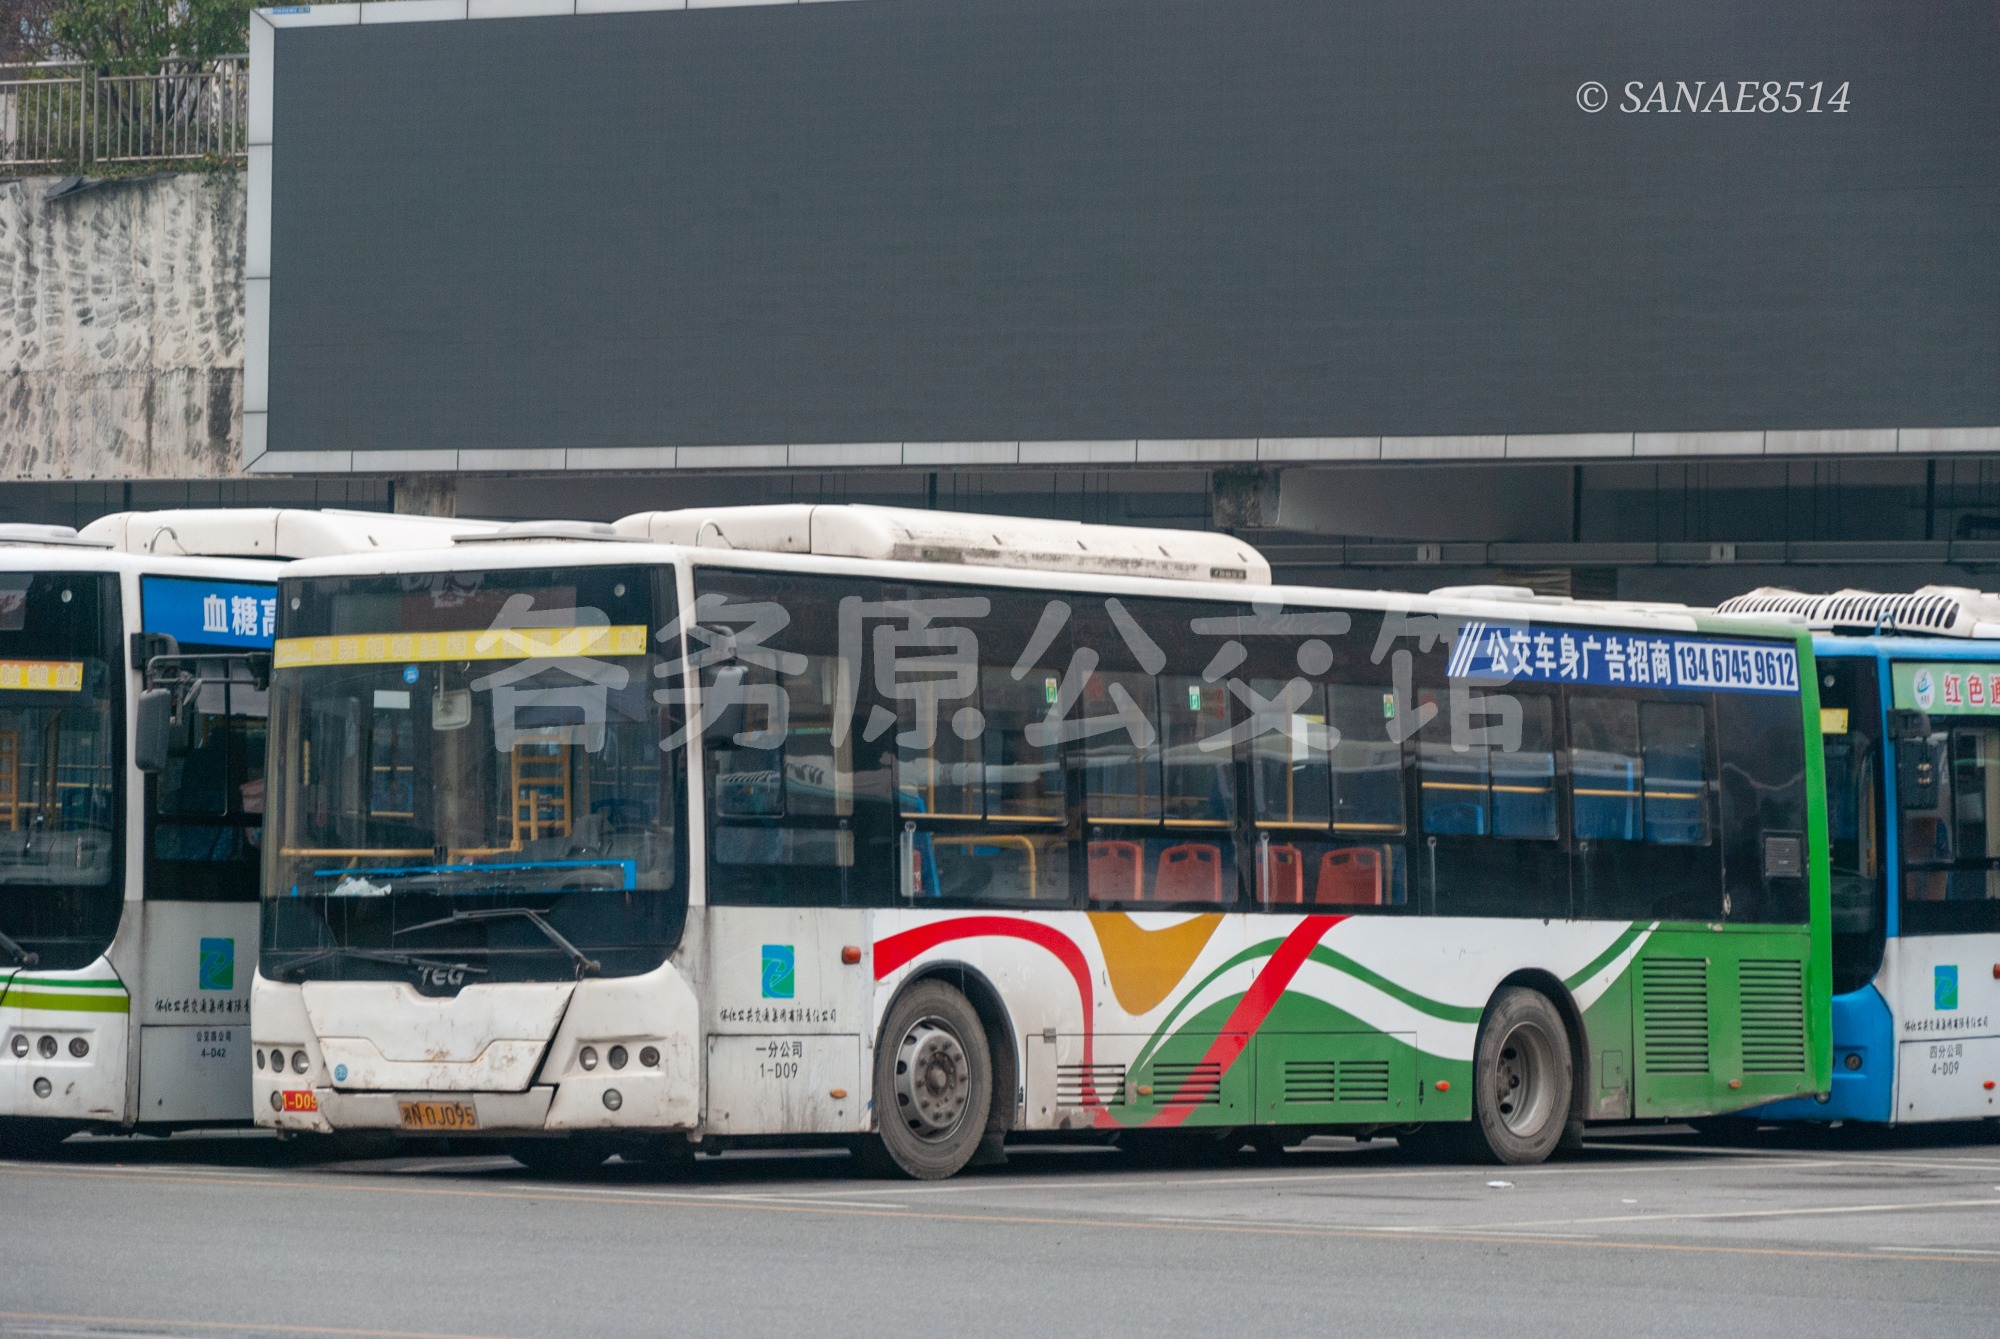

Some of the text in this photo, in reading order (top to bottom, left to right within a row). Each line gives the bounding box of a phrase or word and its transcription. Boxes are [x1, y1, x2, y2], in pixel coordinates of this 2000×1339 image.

[1486, 629, 1671, 686] 公交车身广告招商
[201, 1048, 226, 1058] 4-D42
[755, 1041, 803, 1059] 一分公司
[1929, 1043, 1963, 1059] 四分公司
[760, 1062, 798, 1079] 1-D09
[1931, 1061, 1960, 1075] 4-D09
